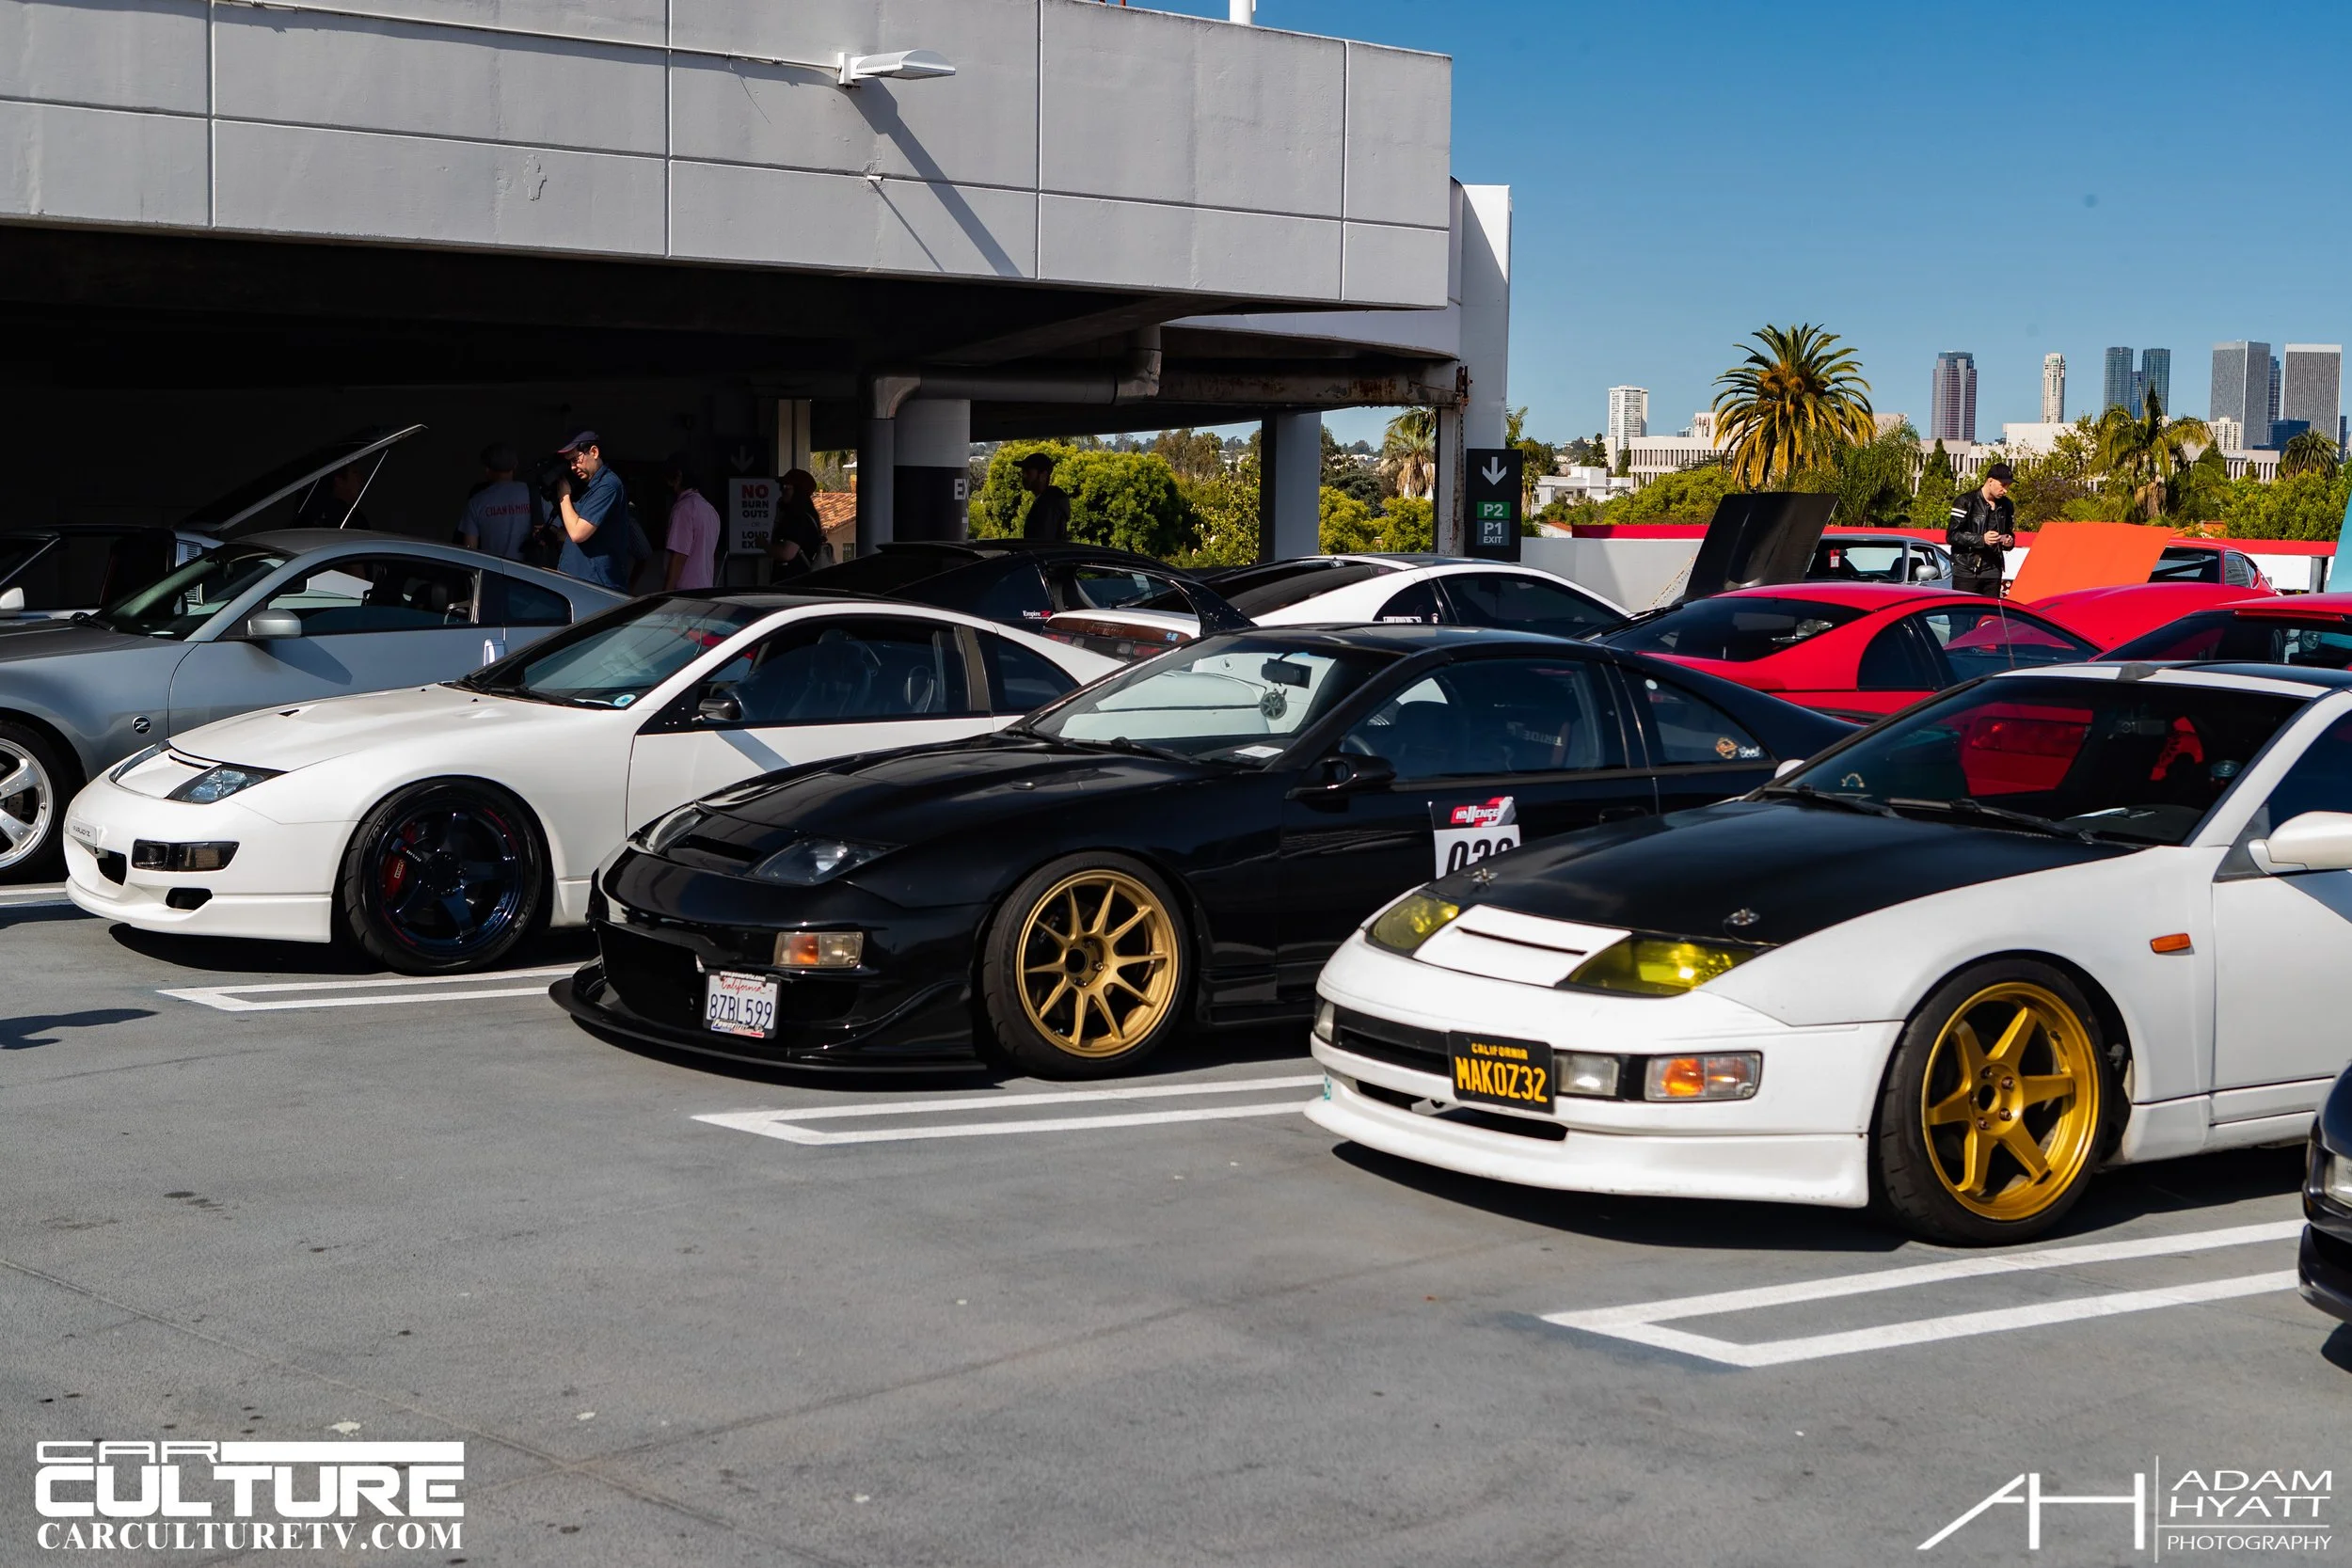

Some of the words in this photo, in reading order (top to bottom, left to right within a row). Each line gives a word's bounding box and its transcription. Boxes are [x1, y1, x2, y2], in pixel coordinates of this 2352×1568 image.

[741, 484, 769, 499] NO
[741, 500, 769, 509] BURN
[1484, 503, 1503, 516] P2
[741, 510, 769, 518] OUTS
[1484, 522, 1502, 535] P1
[721, 976, 763, 995] California
[1471, 1042, 1529, 1061] CALIFORNIA
